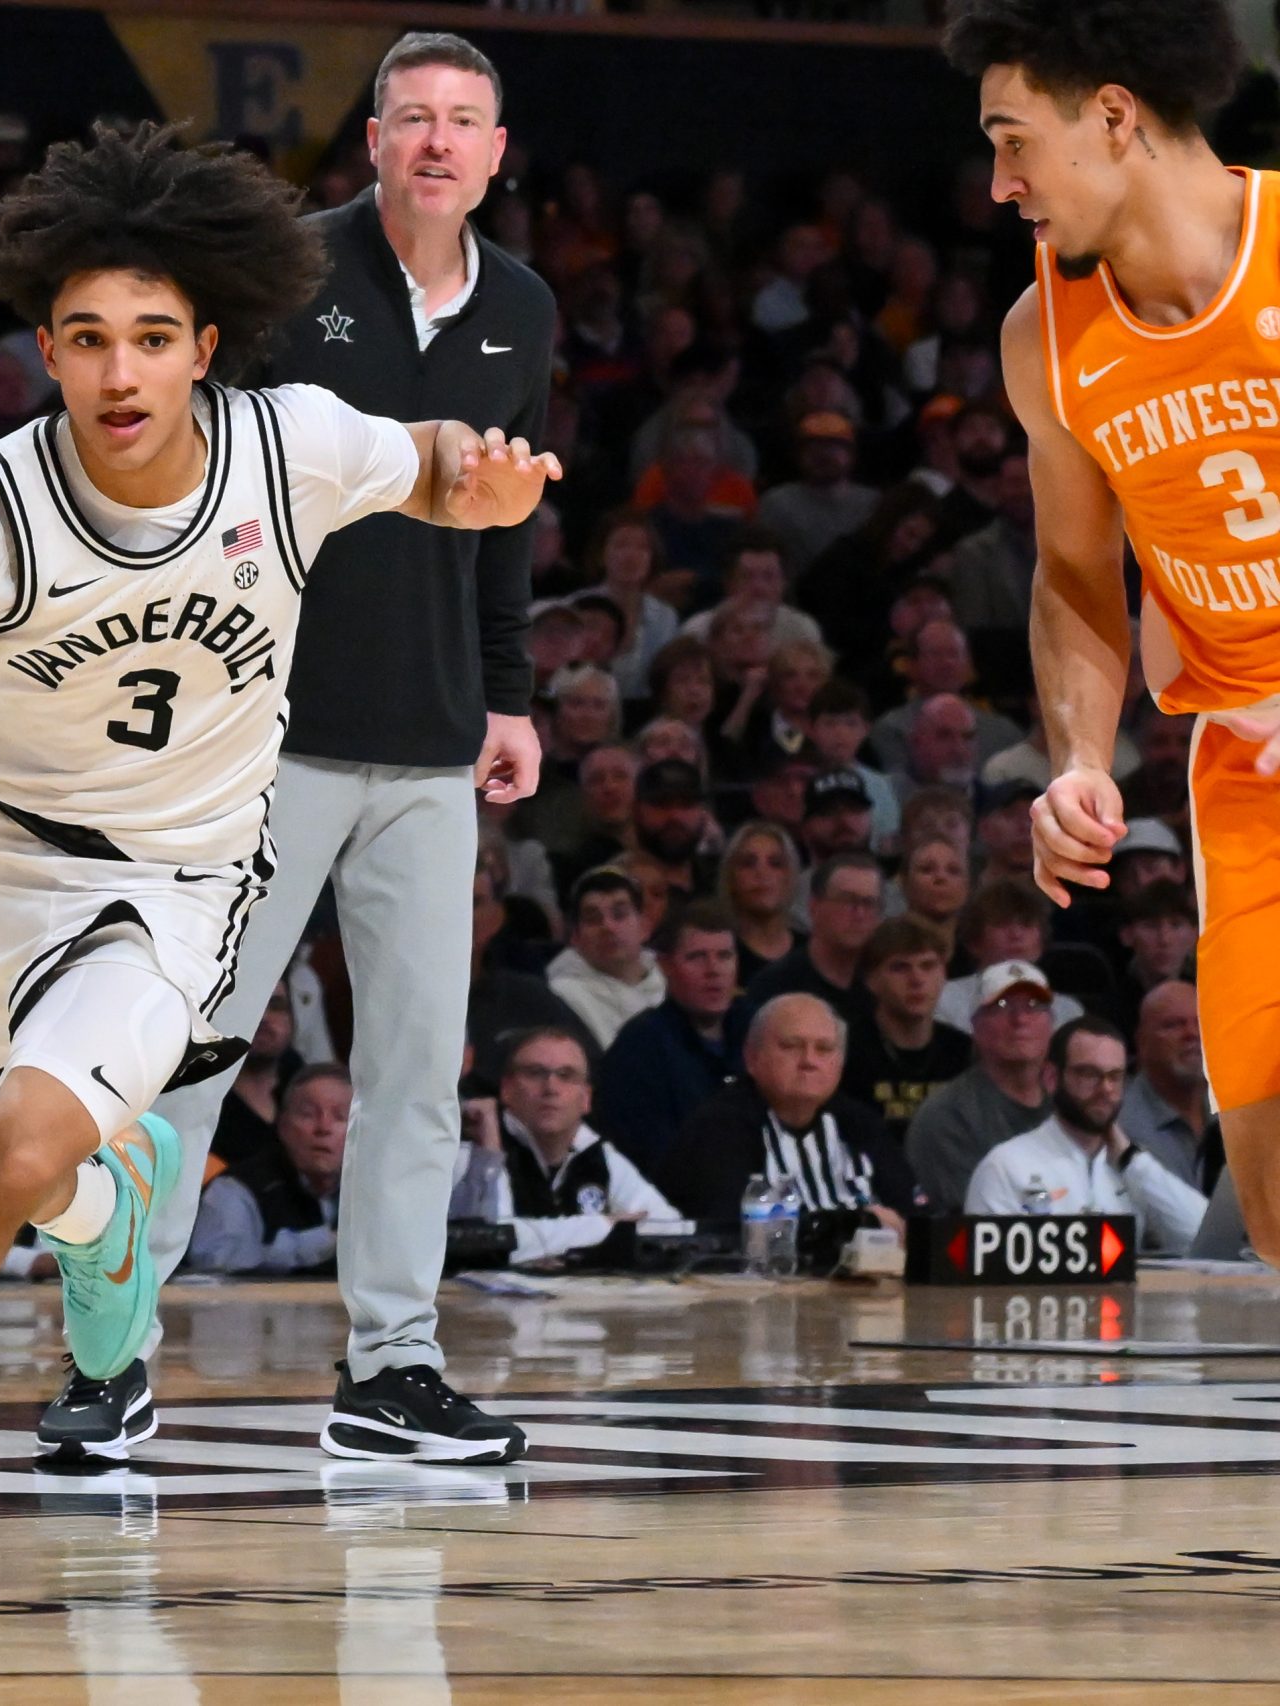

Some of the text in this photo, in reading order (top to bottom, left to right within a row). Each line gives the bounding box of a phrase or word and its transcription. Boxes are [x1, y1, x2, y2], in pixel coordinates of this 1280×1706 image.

[205, 41, 303, 148] E
[1258, 308, 1280, 338] SE
[1093, 376, 1280, 473] TENNESS
[1198, 449, 1280, 542] 3
[235, 562, 258, 589] SEC
[1151, 544, 1280, 612] VOLUN
[7, 592, 276, 694] VANDERBILT
[106, 668, 181, 752] 3
[974, 1221, 1097, 1276] POSS.
